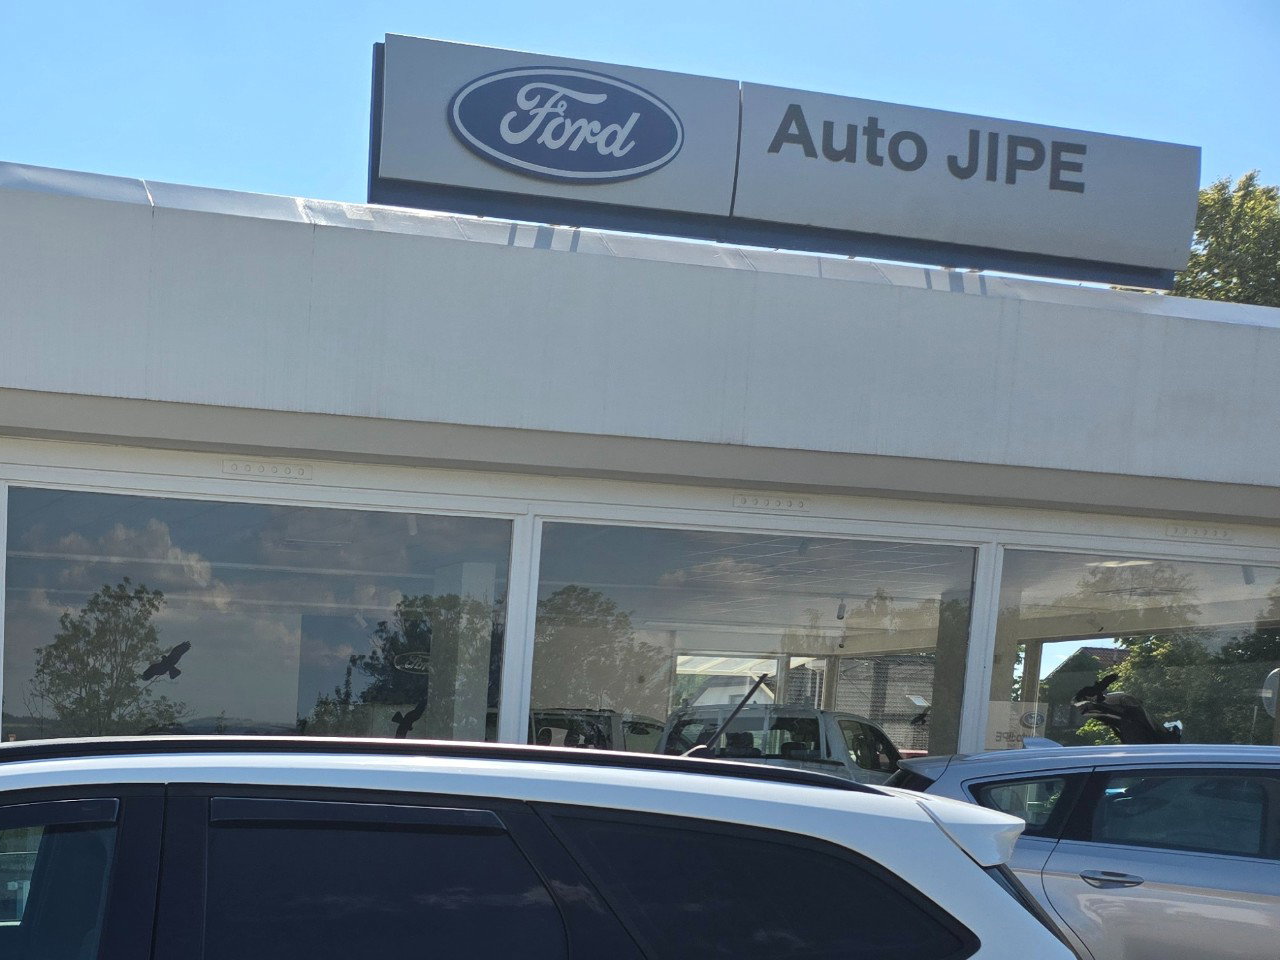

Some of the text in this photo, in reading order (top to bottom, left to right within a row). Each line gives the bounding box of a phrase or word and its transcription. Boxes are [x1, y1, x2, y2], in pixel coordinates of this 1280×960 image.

[499, 81, 642, 159] Ford
[766, 103, 1088, 194] Auto JIPE
